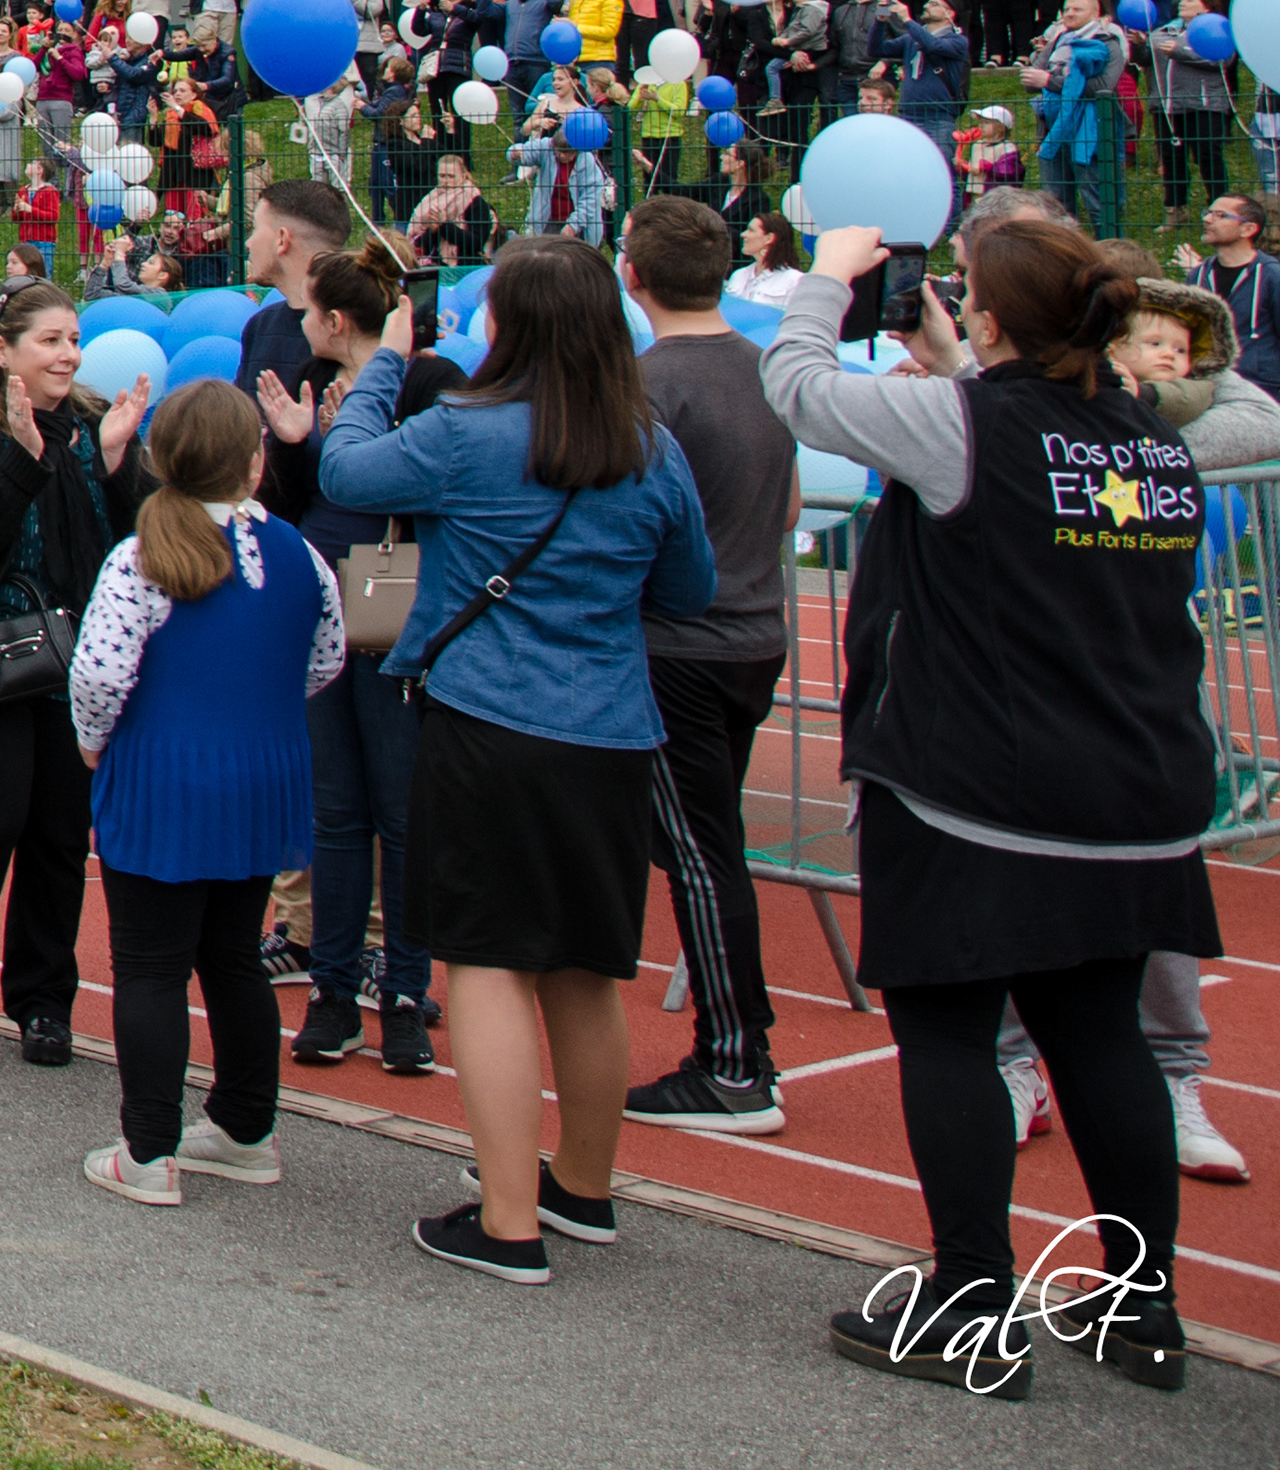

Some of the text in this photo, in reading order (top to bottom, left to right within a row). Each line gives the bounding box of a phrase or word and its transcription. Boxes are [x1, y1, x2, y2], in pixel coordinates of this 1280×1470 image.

[1048, 470, 1198, 525] Etiles
[1054, 528, 1094, 547] Plus
[1097, 531, 1137, 549] Forts
